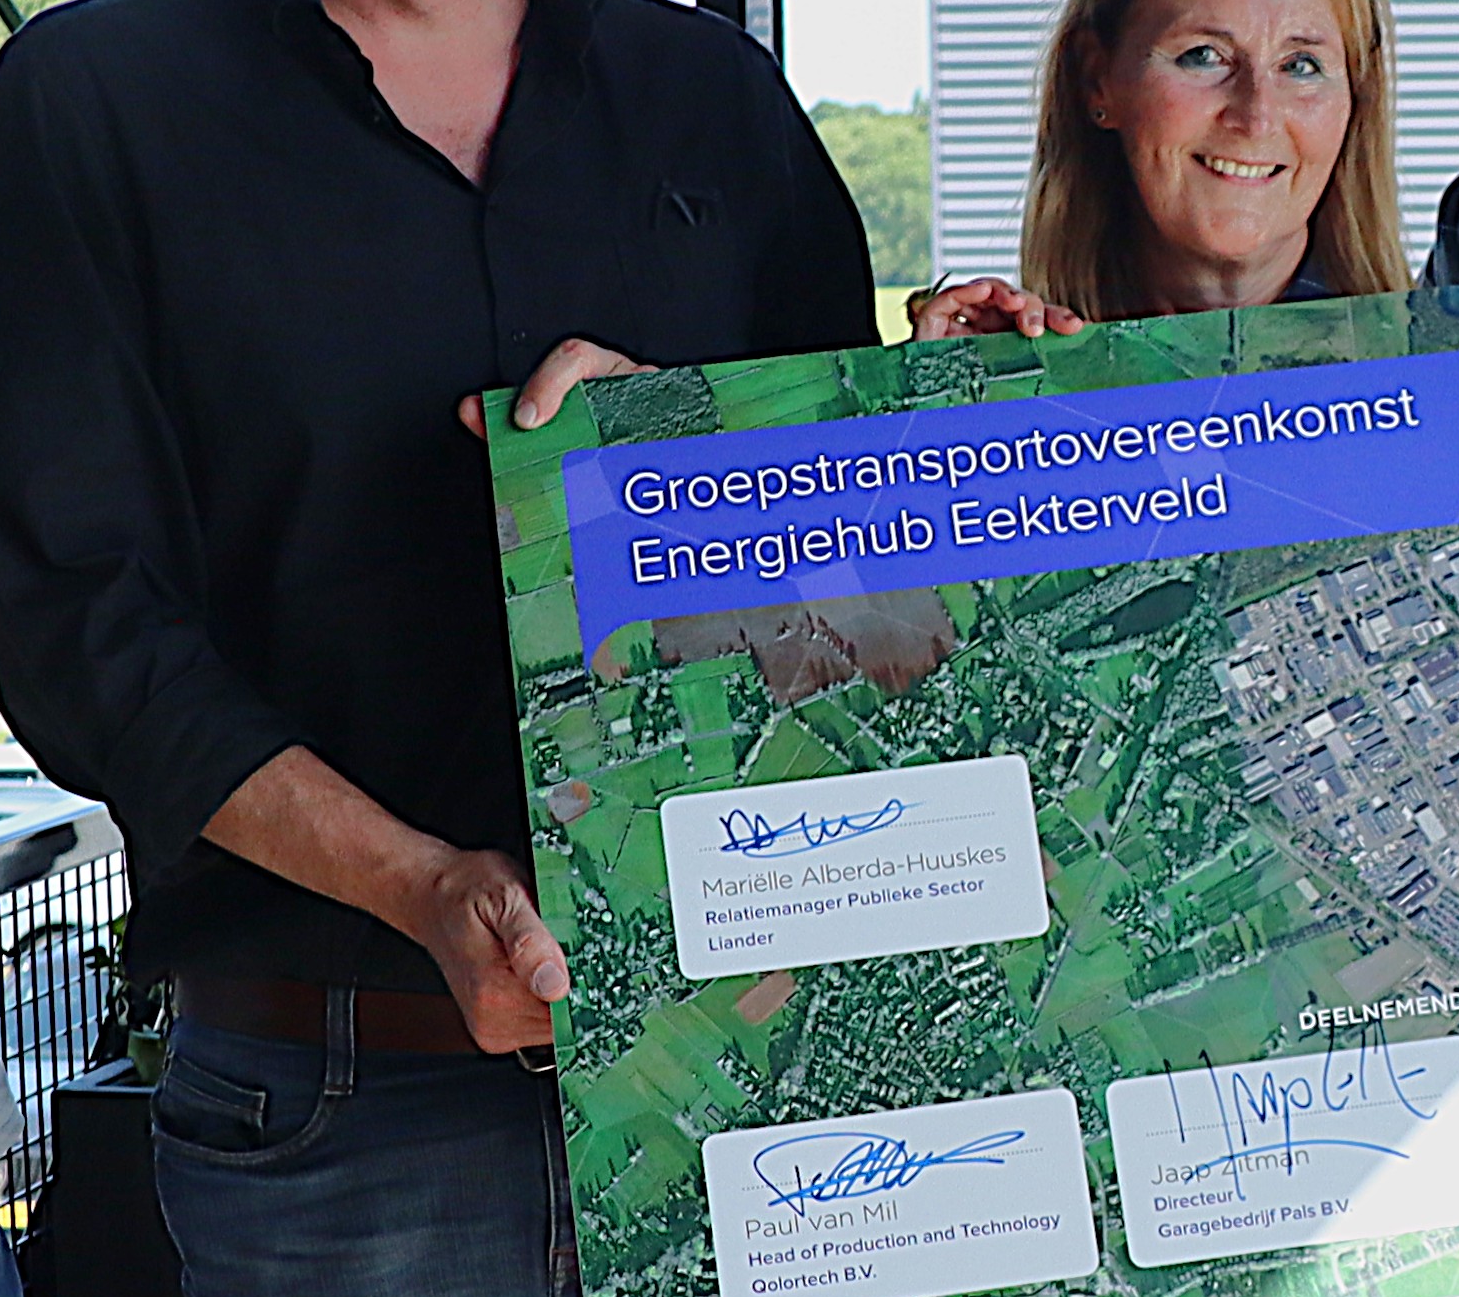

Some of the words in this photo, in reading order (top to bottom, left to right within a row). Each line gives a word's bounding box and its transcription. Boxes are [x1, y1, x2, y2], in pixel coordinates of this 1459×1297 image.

[623, 386, 1420, 522] Groepstransportovereenkomst
[631, 511, 936, 584] Energiehub
[951, 472, 1229, 547] Eekterveld
[702, 864, 794, 900] Mariëlle
[801, 844, 1008, 888] Alberda-Huuskes
[706, 893, 842, 926] Relatiemanager
[848, 883, 924, 908] Publieke
[929, 877, 985, 898] Sector
[708, 930, 774, 952] Liander
[1151, 1161, 1211, 1187] Jaap
[1220, 1146, 1310, 1177] Zitman
[746, 1211, 801, 1240] Paul
[809, 1212, 855, 1232] van
[863, 1200, 899, 1224] Mil
[1154, 1188, 1234, 1212] Directeur
[748, 1244, 796, 1268] Head
[801, 1242, 819, 1260] of
[823, 1232, 918, 1257] Production
[923, 1225, 956, 1244] and
[960, 1213, 1061, 1241] Technology
[1158, 1208, 1276, 1240] Garagebedrijf
[1281, 1202, 1317, 1222] Pals
[752, 1269, 839, 1295] Qolortech
[844, 1264, 877, 1283] B.V.
